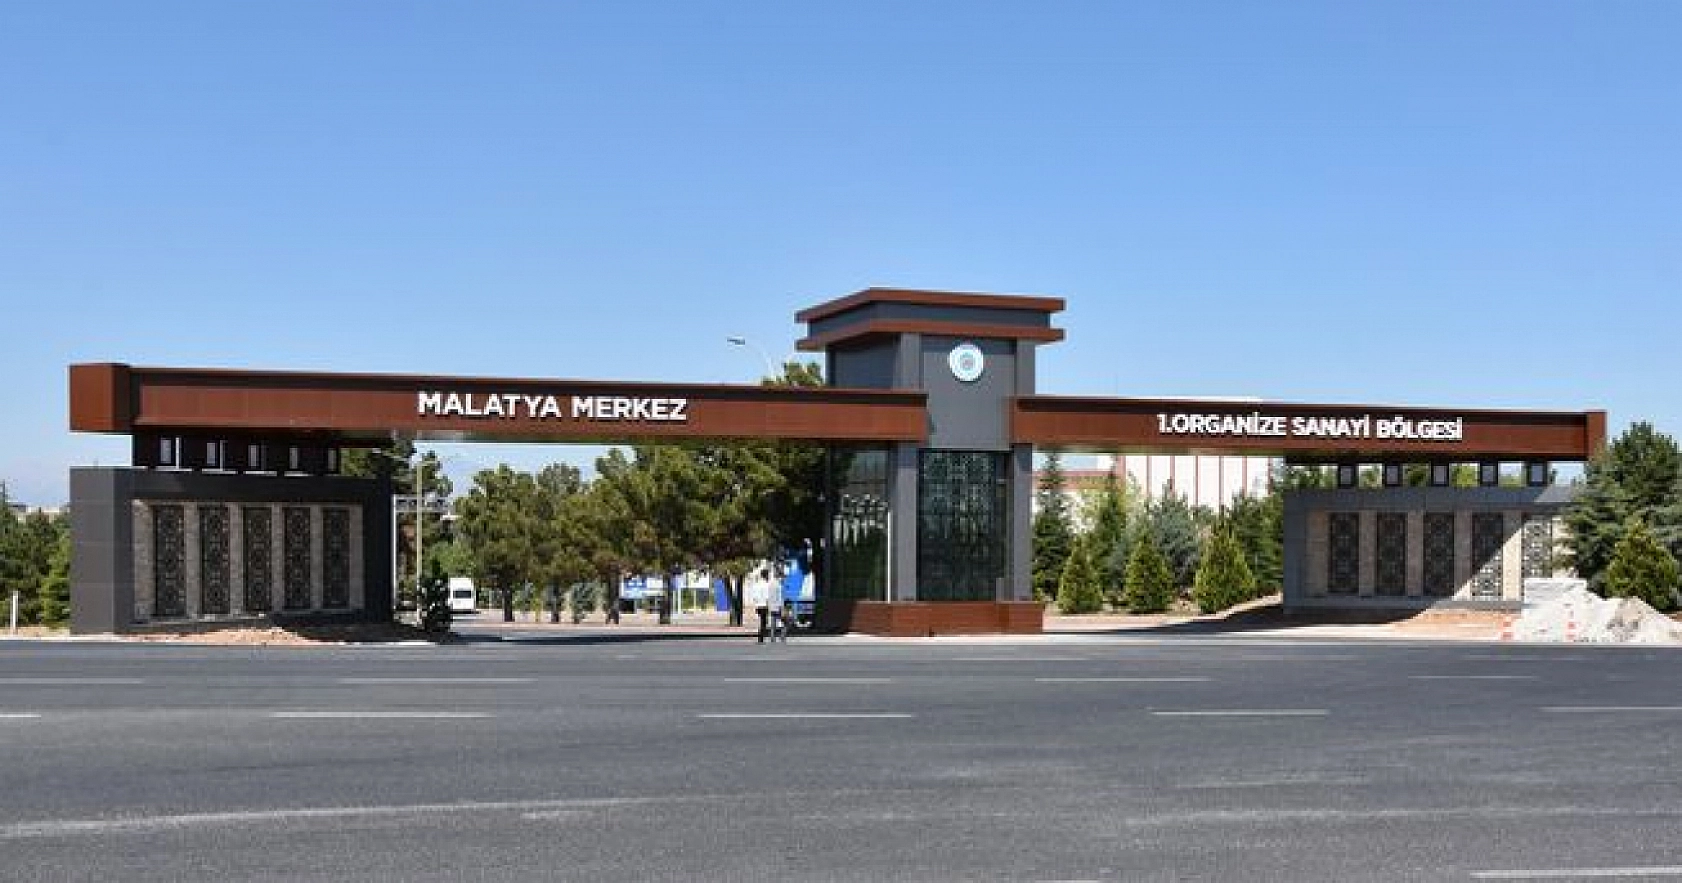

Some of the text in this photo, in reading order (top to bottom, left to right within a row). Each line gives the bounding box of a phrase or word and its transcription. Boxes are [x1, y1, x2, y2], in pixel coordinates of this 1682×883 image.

[417, 391, 686, 420] MALATYA MERKEZ
[1291, 414, 1369, 438] SANAYİ
[1376, 416, 1462, 440] BÖLGESİ
